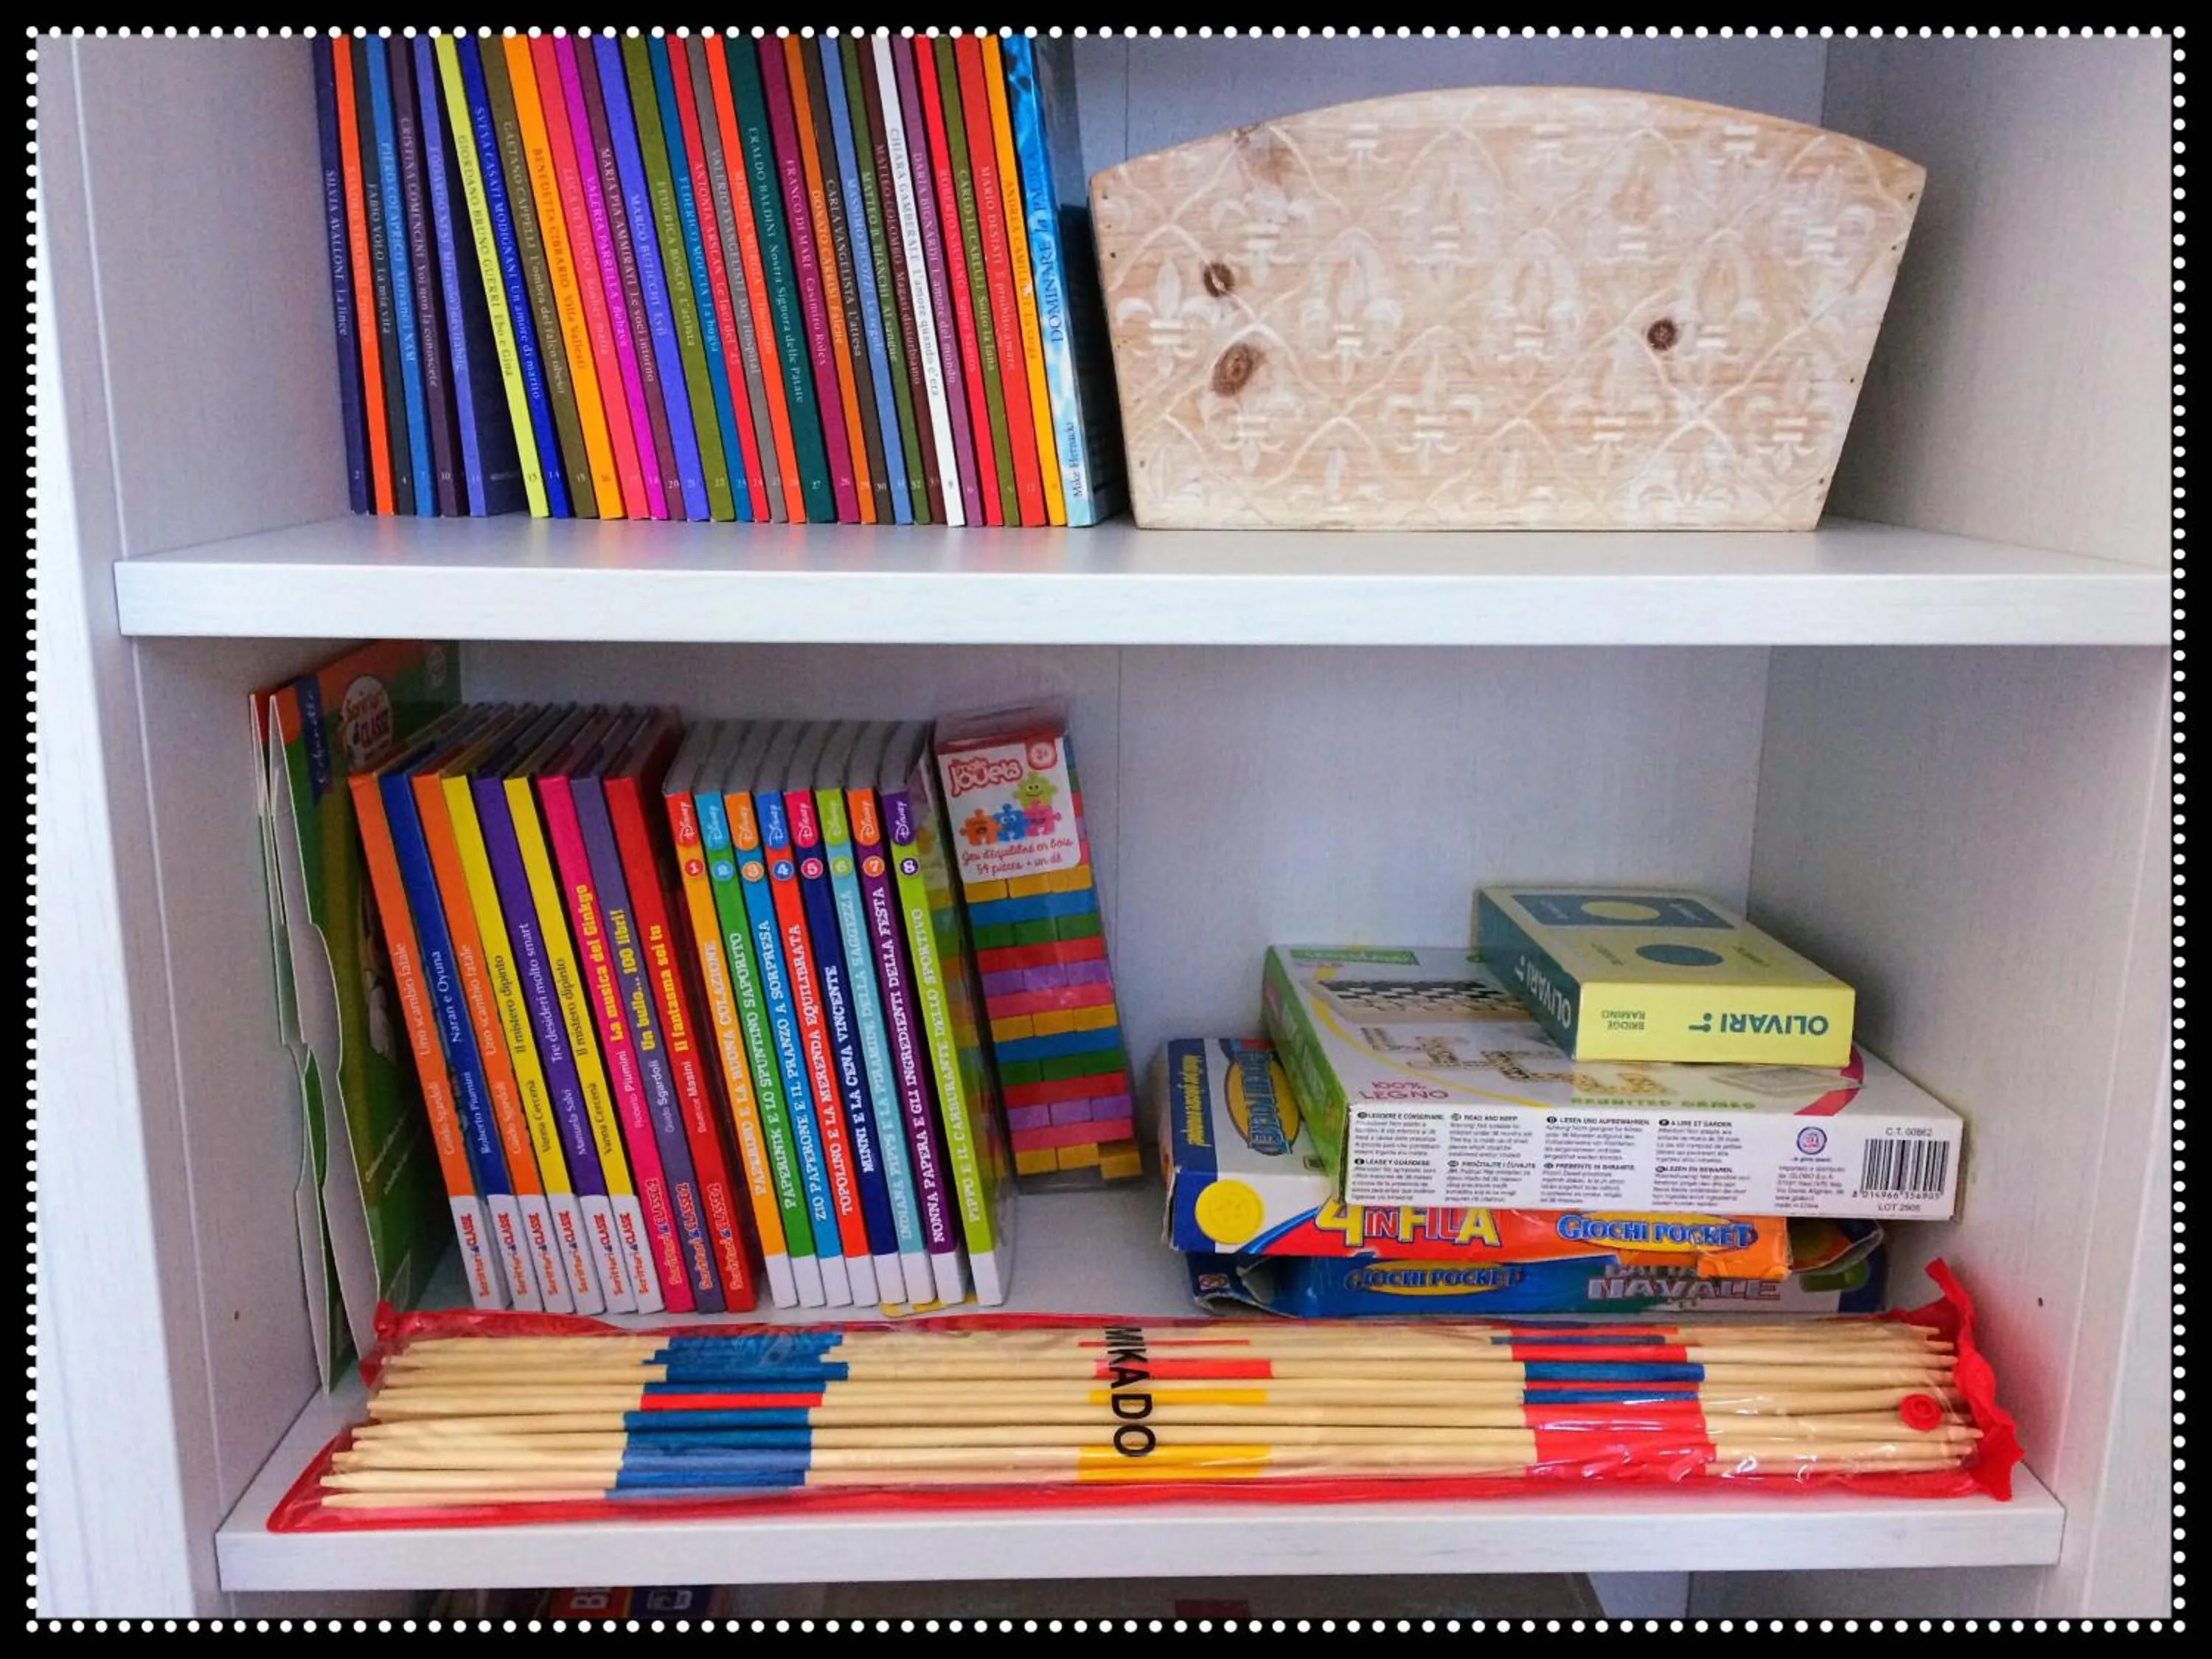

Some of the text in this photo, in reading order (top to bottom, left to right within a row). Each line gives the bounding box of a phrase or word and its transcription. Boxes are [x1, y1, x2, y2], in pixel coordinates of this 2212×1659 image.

[600, 147, 617, 190] MARIA
[959, 169, 973, 213] CARLO
[609, 193, 622, 216] PIA
[826, 178, 841, 223] CARLA
[326, 170, 338, 212] SILVIA
[337, 306, 348, 335] lince
[366, 183, 392, 334] FABIO VOLO La mia vita
[748, 127, 804, 403] ERALDO BALDINI Nostra Signora delle Patate
[833, 226, 855, 304] VANGELISTA
[889, 128, 906, 179] CHIARA
[898, 183, 919, 262] GAMBERALE
[919, 320, 936, 364] quando
[976, 295, 990, 327] Sotto
[1036, 238, 1063, 342] DOMINARE
[633, 308, 646, 334] voci
[981, 330, 992, 341] la
[638, 337, 655, 382] intorno
[609, 907, 631, 945] libri!
[574, 882, 623, 1040] La musica del Ginkgo
[619, 947, 638, 974] 100
[393, 942, 431, 1056] Uno scambio fatale
[429, 949, 462, 1043] Naran e Oyuna
[490, 953, 526, 1054] Il mistero dipinto
[518, 922, 563, 1062] Tre desideri molto smart
[554, 956, 588, 1056] Il mistero dipinto
[648, 925, 689, 1051] Il fantasma sei tu
[1527, 960, 1571, 1029] OLIVARI
[1601, 1009, 1645, 1020] RAMINO
[1607, 1020, 1645, 1031] BRIDGE
[1721, 1015, 1829, 1036] OLIVARI
[640, 1029, 656, 1050] Un
[616, 1050, 636, 1092] Piumini
[647, 1058, 671, 1106] Sgardoli
[681, 1060, 700, 1097] Masini
[703, 939, 768, 1196] PAPERINO E LA BUONA COLAZIONE
[728, 931, 798, 1208] PAPERINIK E LO SPUNTINO SAPORITO
[757, 919, 827, 1220] ZIO PAPERONE E IL PRANZO A SORPRESA
[787, 924, 854, 1216] TOPOLINO E LA MERENDA EQUILIBRATA
[824, 964, 875, 1172] MINNI E LA CENA VINCENTE
[872, 887, 945, 1243] NONNA PAPERA E GLI INGREDIENTI DELLA FESTA
[910, 908, 981, 1222] PIPPO E IL CARBURANTE DELLO SPORTIVO
[561, 1088, 576, 1112] Salvi
[1359, 1090, 1449, 1100] LEGNO
[459, 1212, 479, 1246] CLASSE
[1315, 1197, 1501, 1247] 4 IN FILA
[1879, 1203, 1897, 1211] LOT
[1557, 1214, 1758, 1249] GIOCHI POCKET
[1346, 1266, 1523, 1291] GIOCHI POCKET
[1587, 1278, 1782, 1301] NAVALE
[1105, 1326, 1157, 1458] MIKADO
